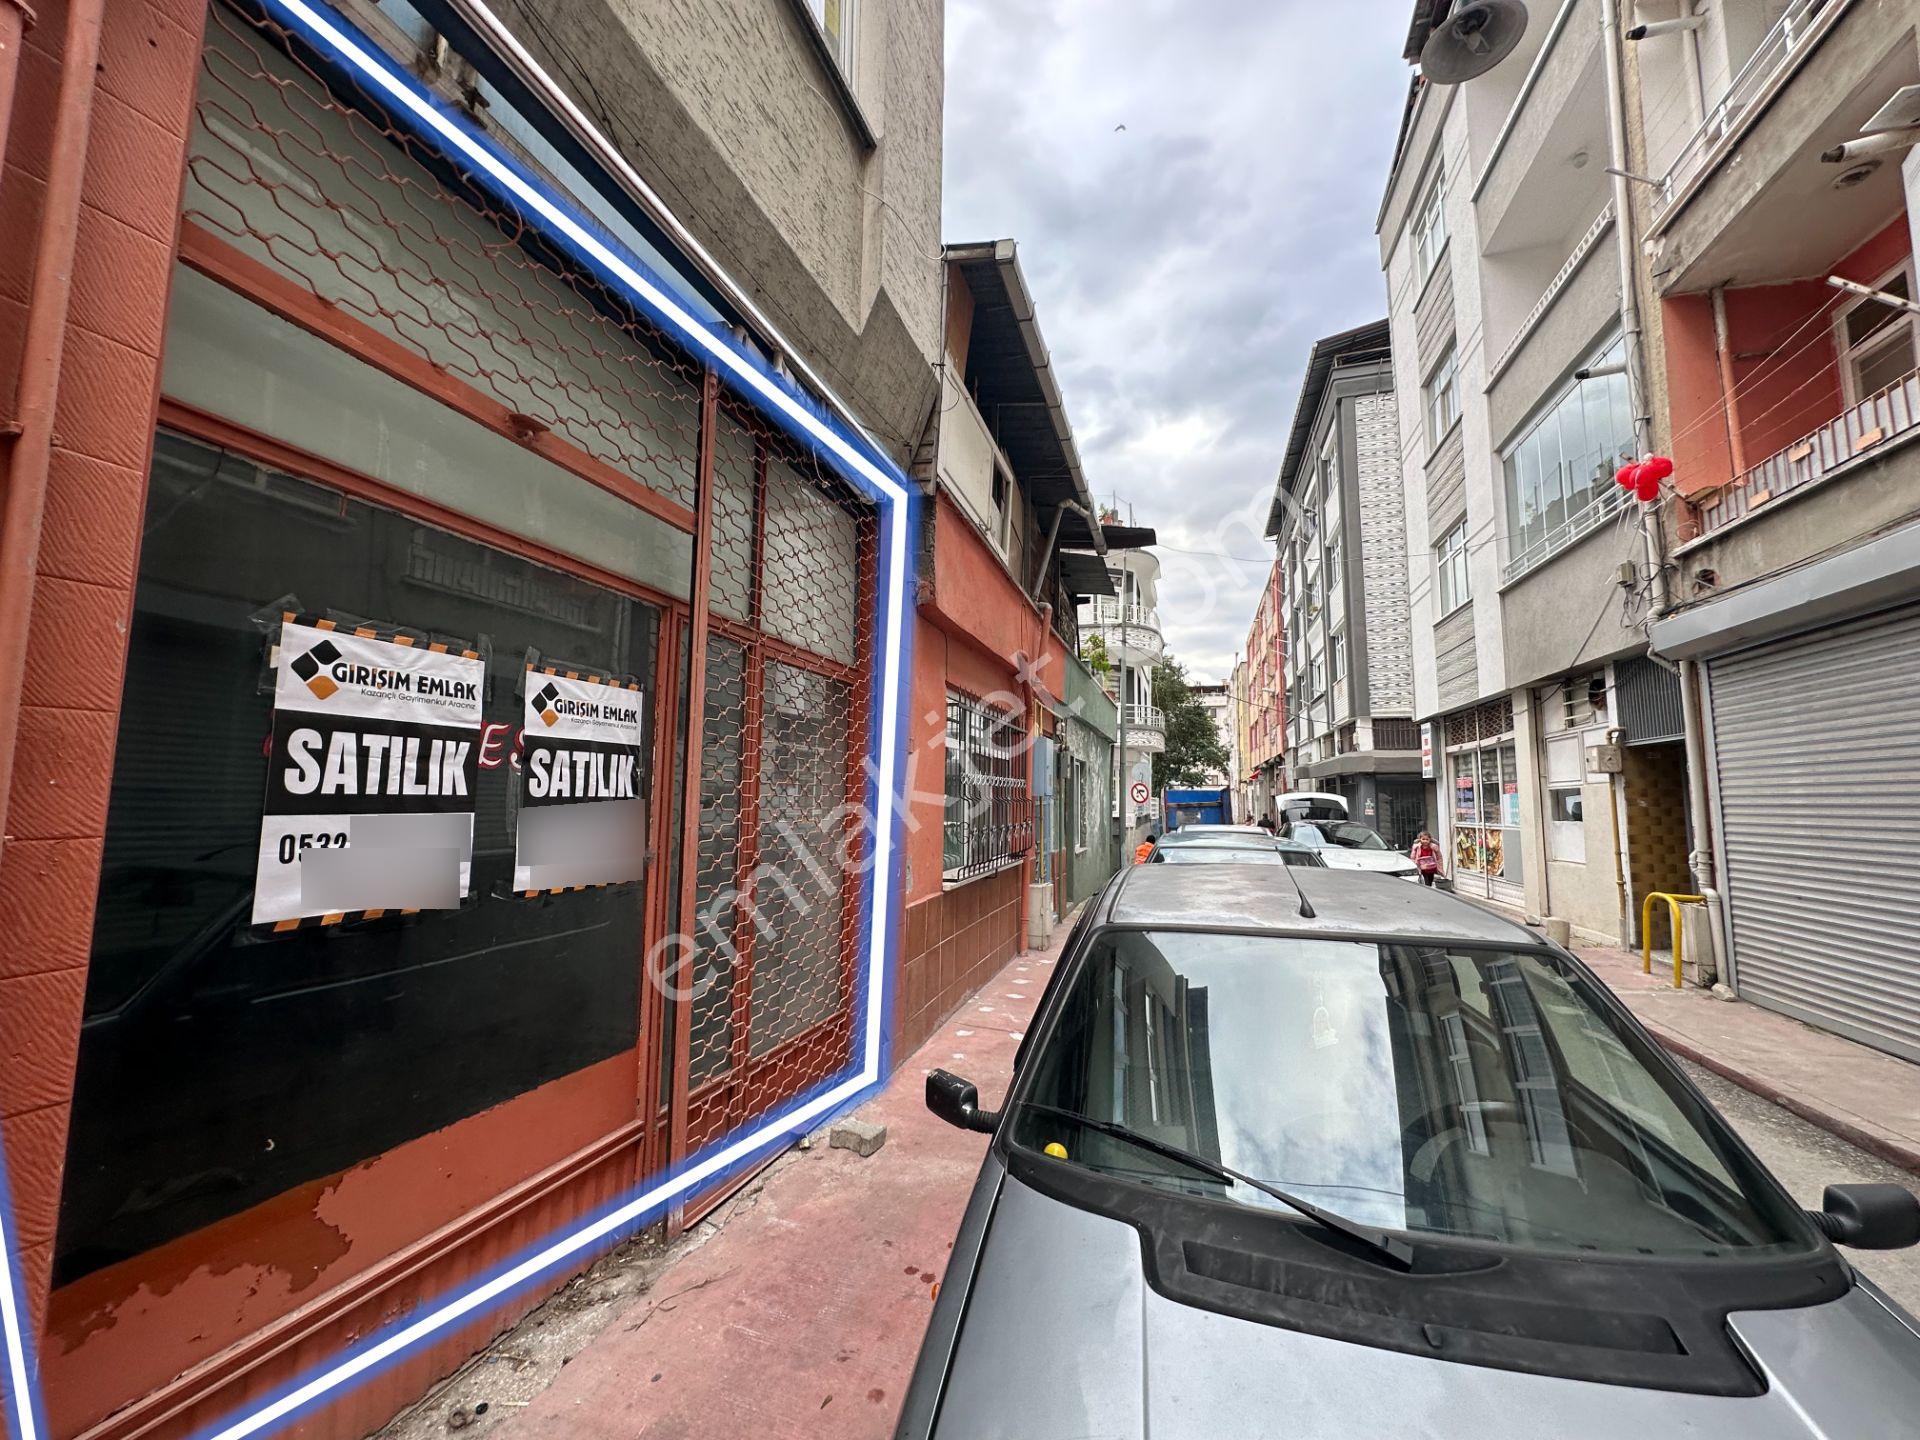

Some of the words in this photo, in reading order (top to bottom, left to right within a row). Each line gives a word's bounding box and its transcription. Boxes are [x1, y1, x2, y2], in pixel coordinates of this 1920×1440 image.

[398, 693, 447, 706] Gayrimenkul
[417, 675, 477, 700] EMLAK
[603, 705, 638, 723] EMLAK
[284, 728, 472, 796] SATILIK
[528, 748, 636, 798] SATILIK
